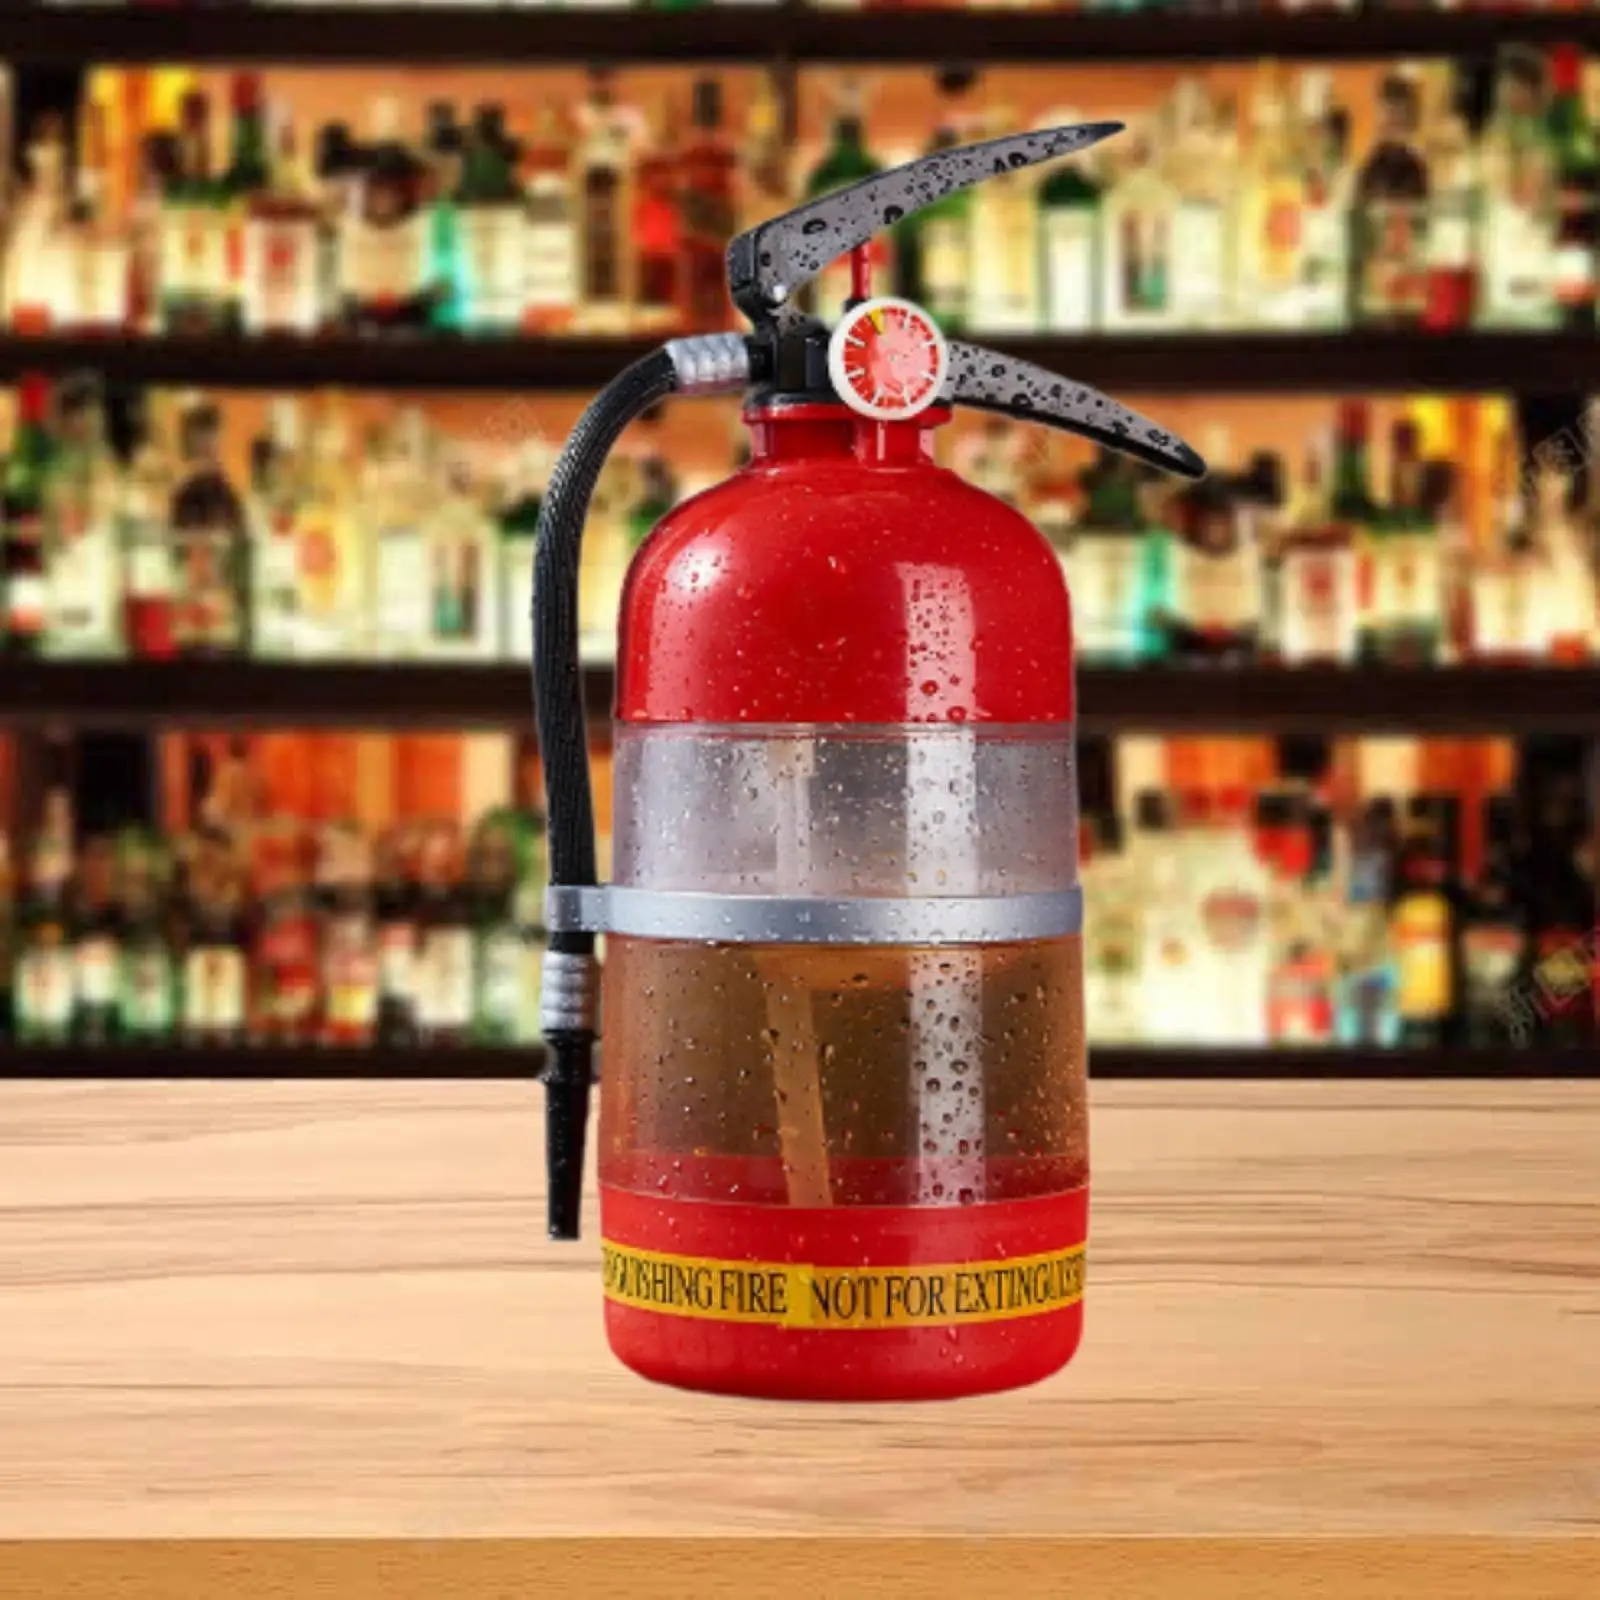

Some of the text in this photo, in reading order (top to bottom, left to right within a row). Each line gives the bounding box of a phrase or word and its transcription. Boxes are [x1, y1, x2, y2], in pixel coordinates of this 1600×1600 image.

[719, 1269, 787, 1314] FIRE
[811, 1276, 877, 1319] NOT
[884, 1275, 946, 1317] FOR
